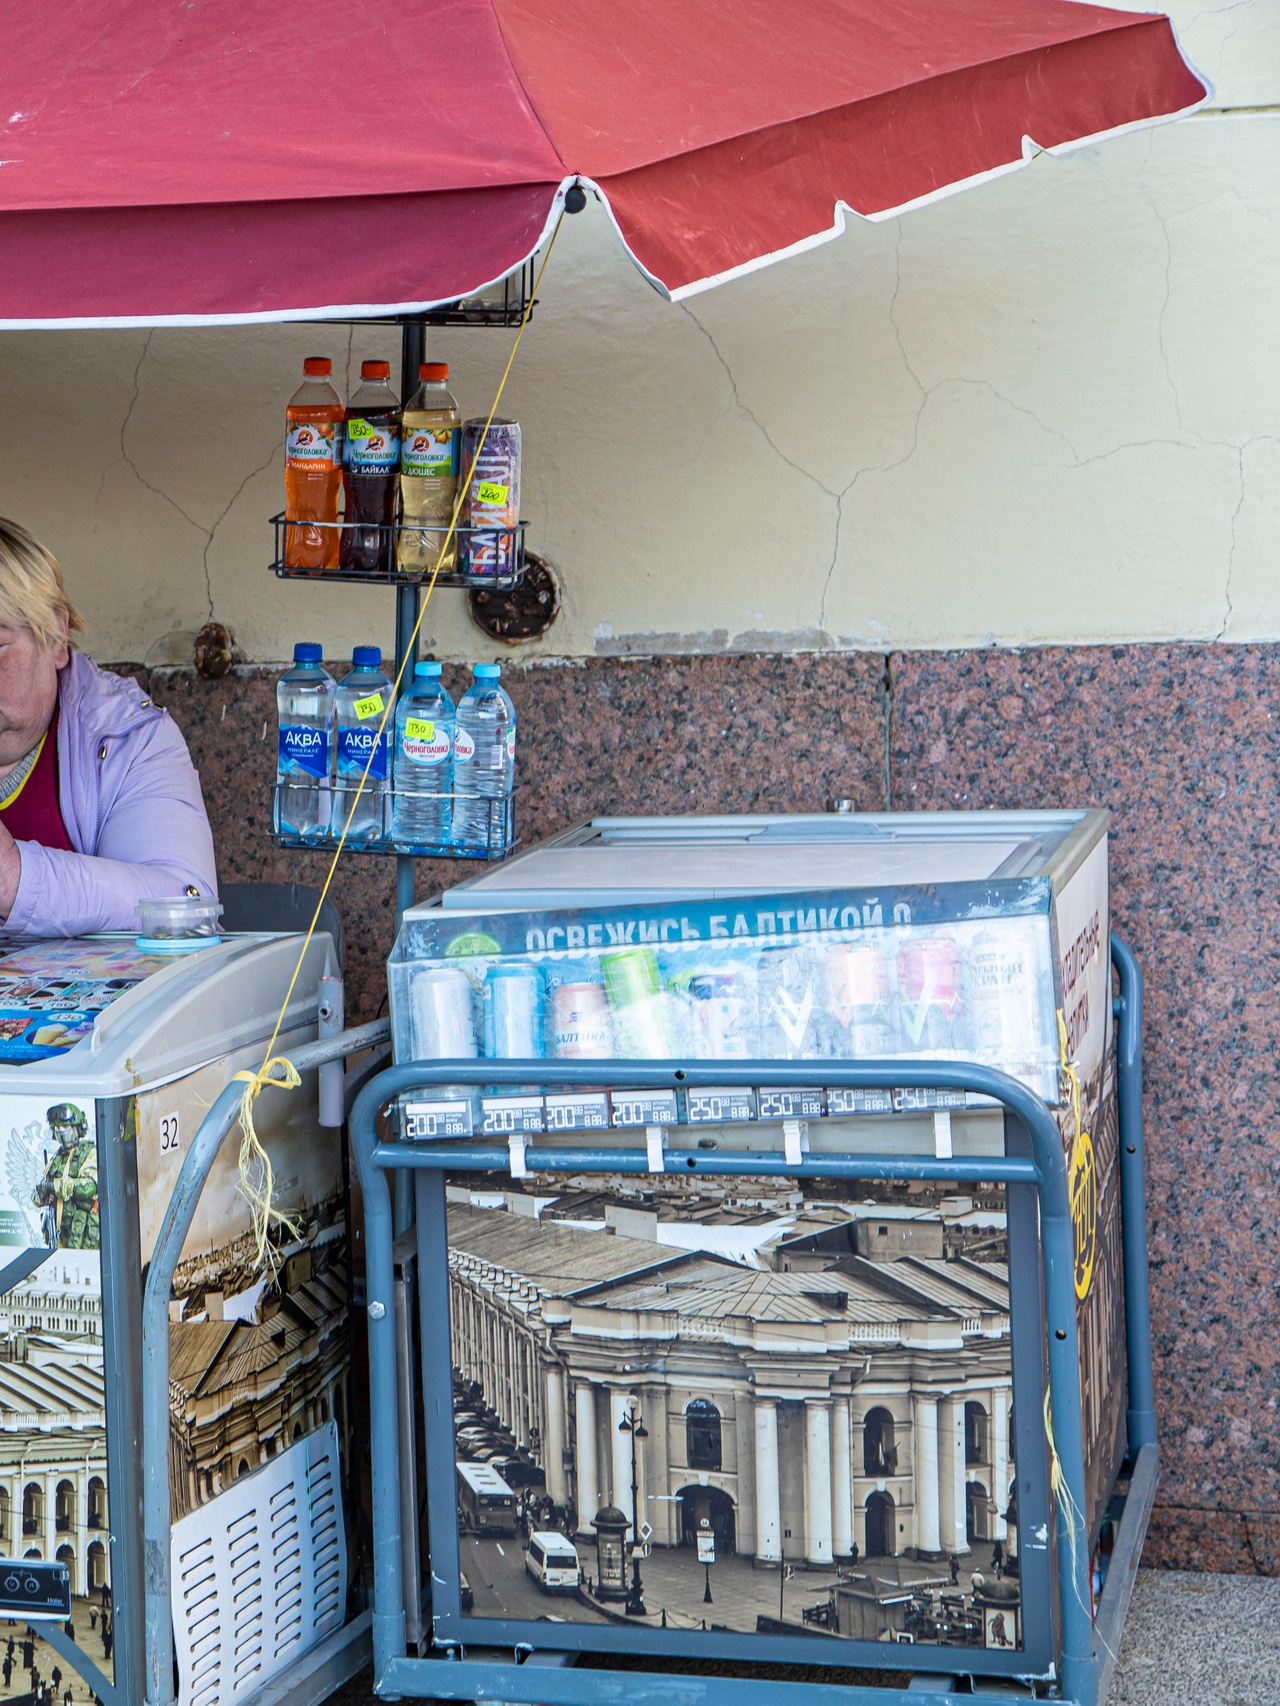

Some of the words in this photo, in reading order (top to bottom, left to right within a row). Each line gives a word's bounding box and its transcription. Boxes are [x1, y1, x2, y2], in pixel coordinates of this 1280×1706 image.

[291, 462, 326, 470] МАНДАРИН
[353, 448, 397, 462] Черноголовка
[361, 464, 390, 474] БАЙКАЛ
[408, 467, 435, 477] ДЮШЕС
[480, 487, 501, 501] 200
[285, 731, 322, 747] АКВА
[345, 732, 382, 749] АКВА
[404, 741, 449, 755] Черноголовка
[526, 919, 701, 962] ОСВЕЖИСЬ
[710, 897, 884, 948] БАЛТИКОЙ
[690, 1097, 722, 1120] 250
[761, 1093, 792, 1116] 250
[827, 1090, 855, 1112] 250
[894, 1088, 928, 1110] 250
[483, 1109, 515, 1132] 200
[546, 1106, 575, 1128] 200
[612, 1102, 644, 1125] 200
[161, 1116, 179, 1150] 32
[407, 1114, 438, 1138] 200
